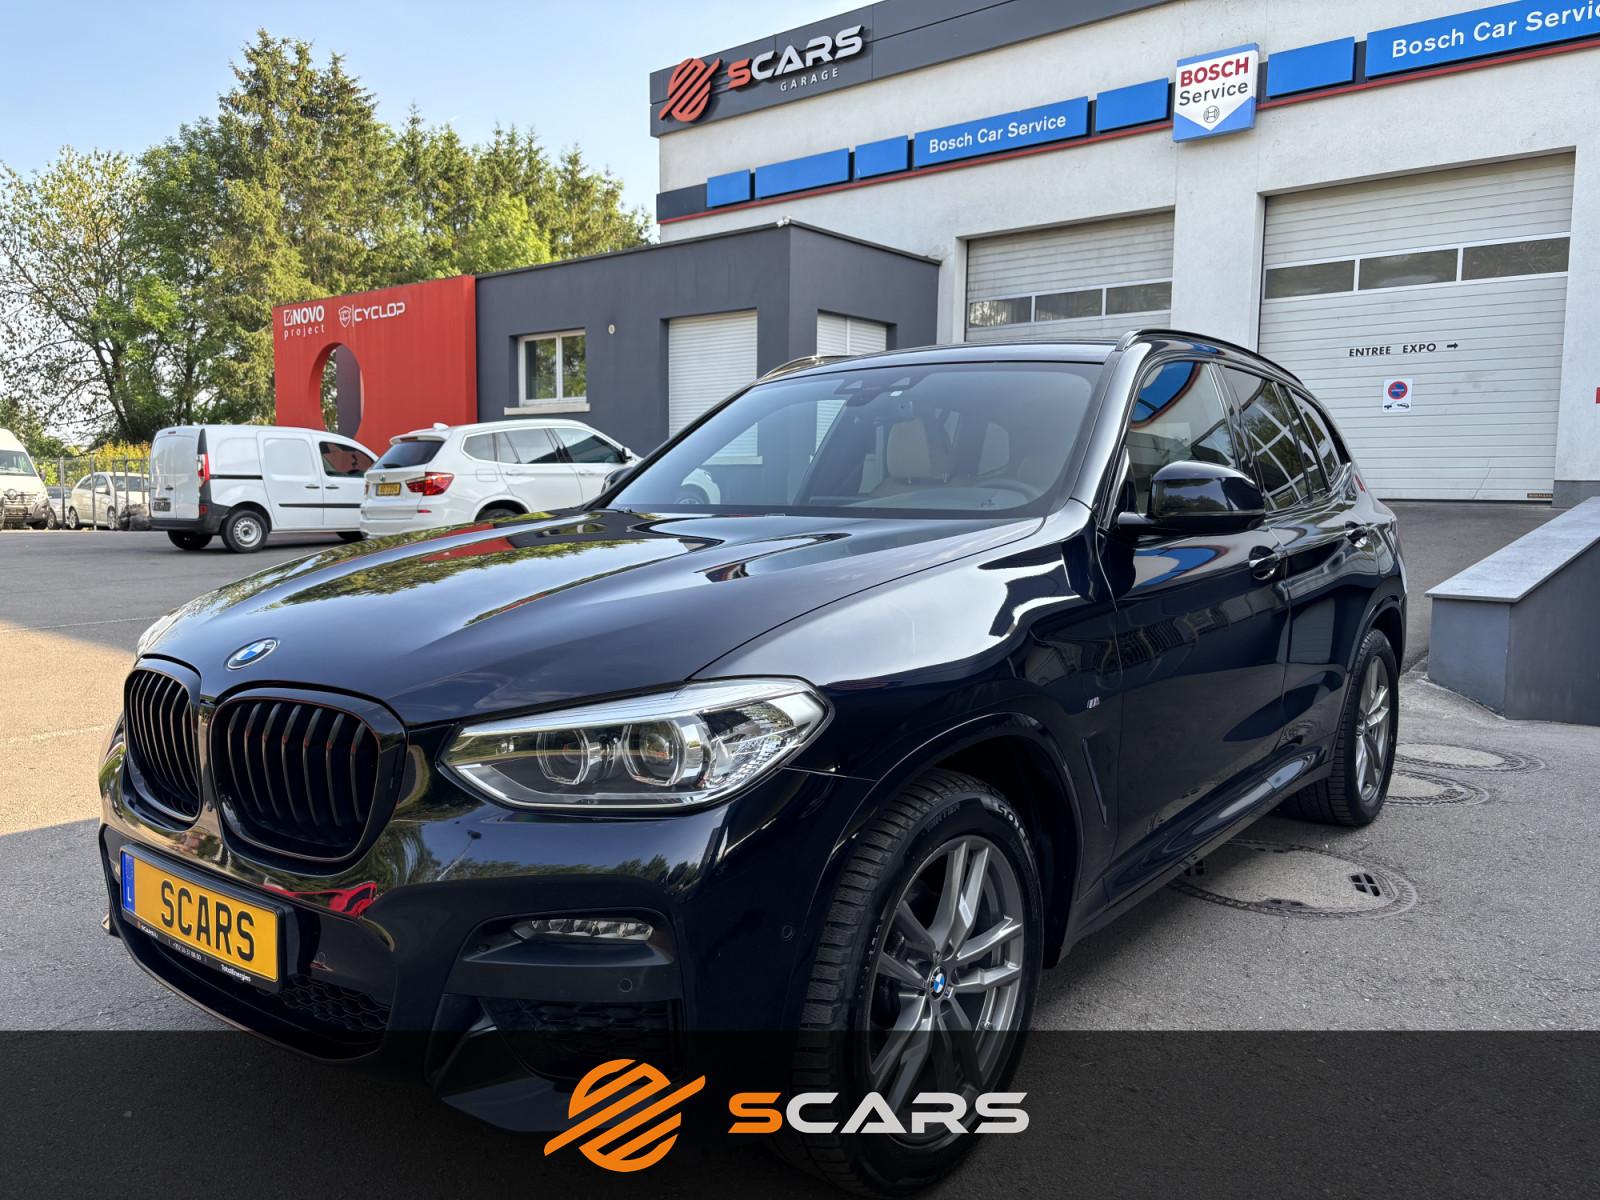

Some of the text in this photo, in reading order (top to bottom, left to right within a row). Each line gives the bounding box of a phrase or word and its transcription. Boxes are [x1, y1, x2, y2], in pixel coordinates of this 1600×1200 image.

[1392, 28, 1465, 58] Bosch
[1473, 20, 1517, 42] Car
[727, 24, 864, 90] SCARS
[780, 67, 839, 92] GARAGE
[1180, 56, 1249, 88] BOSCH
[1179, 80, 1249, 107] Service
[928, 114, 1067, 154] Bosch Car Service
[354, 302, 406, 322] CYCLOP
[283, 324, 325, 341] project
[1349, 342, 1437, 357] ENTREE EXPO
[128, 879, 255, 962] L SCARS
